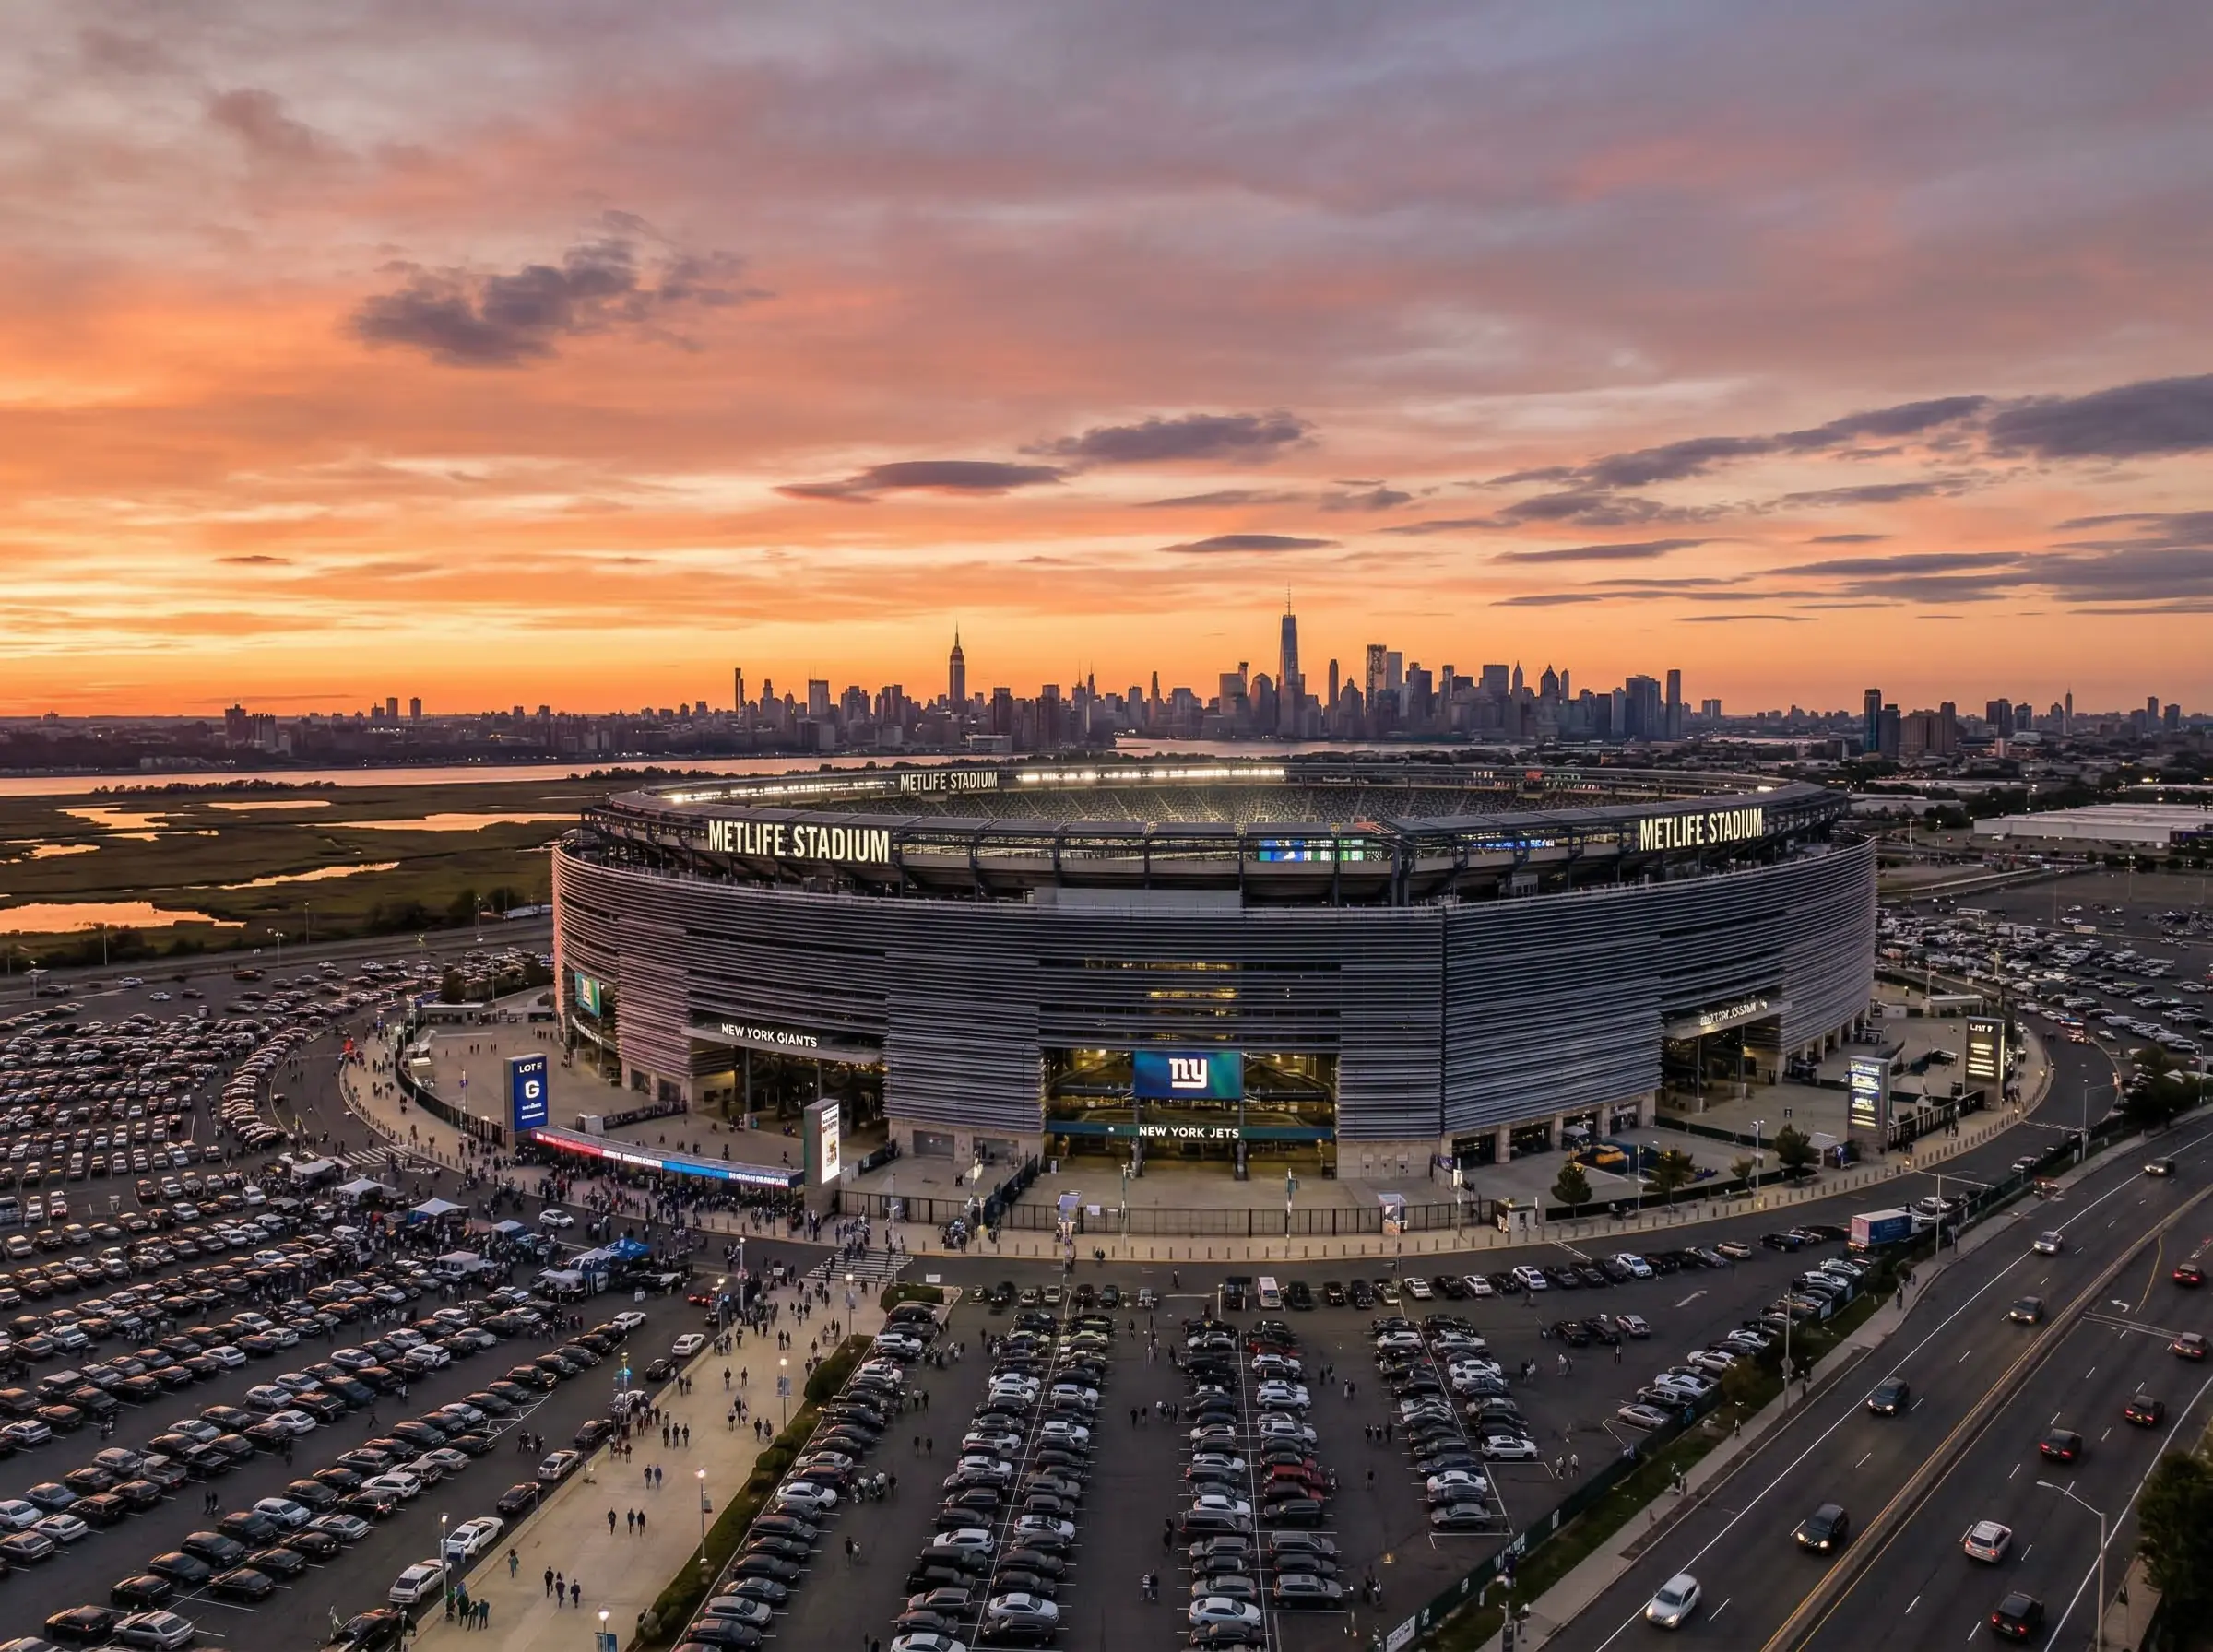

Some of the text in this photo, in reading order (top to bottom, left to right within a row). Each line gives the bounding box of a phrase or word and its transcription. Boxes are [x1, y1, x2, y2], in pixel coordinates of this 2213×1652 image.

[900, 772, 998, 792] METLIFE STADIUM
[1640, 808, 1763, 851] METLIFE STADIUM
[708, 820, 890, 863] METLIFE STADIUM
[721, 1022, 818, 1048] NEW YORK GIANTS
[519, 1063, 537, 1074] LOT
[525, 1080, 540, 1099] G
[1139, 1127, 1240, 1139] NEW YORK JETS
